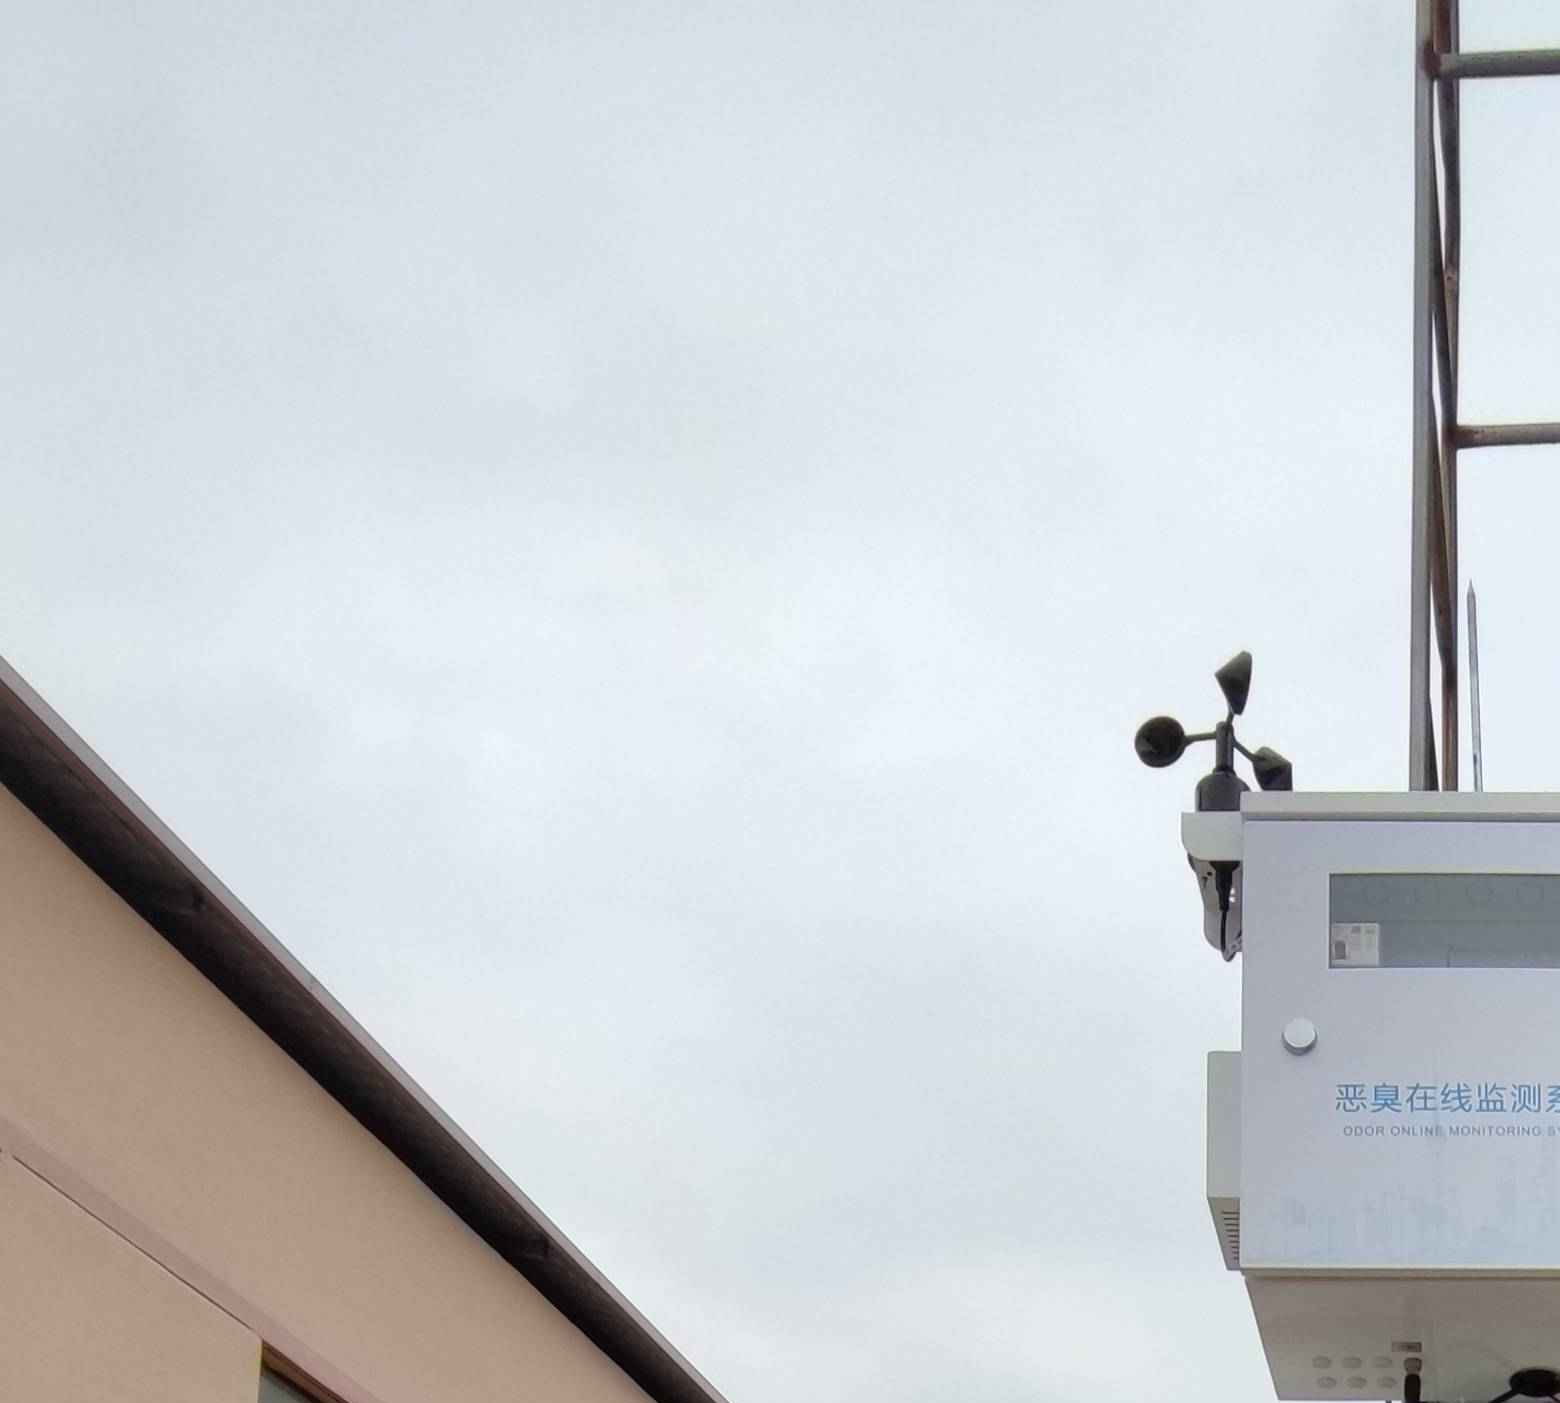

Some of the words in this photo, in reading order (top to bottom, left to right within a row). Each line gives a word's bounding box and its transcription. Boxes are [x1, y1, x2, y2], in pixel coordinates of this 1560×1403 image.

[1343, 1125, 1385, 1137] ODOR
[1390, 1125, 1443, 1137] ONLINE
[1449, 1125, 1541, 1137] MONITORING
